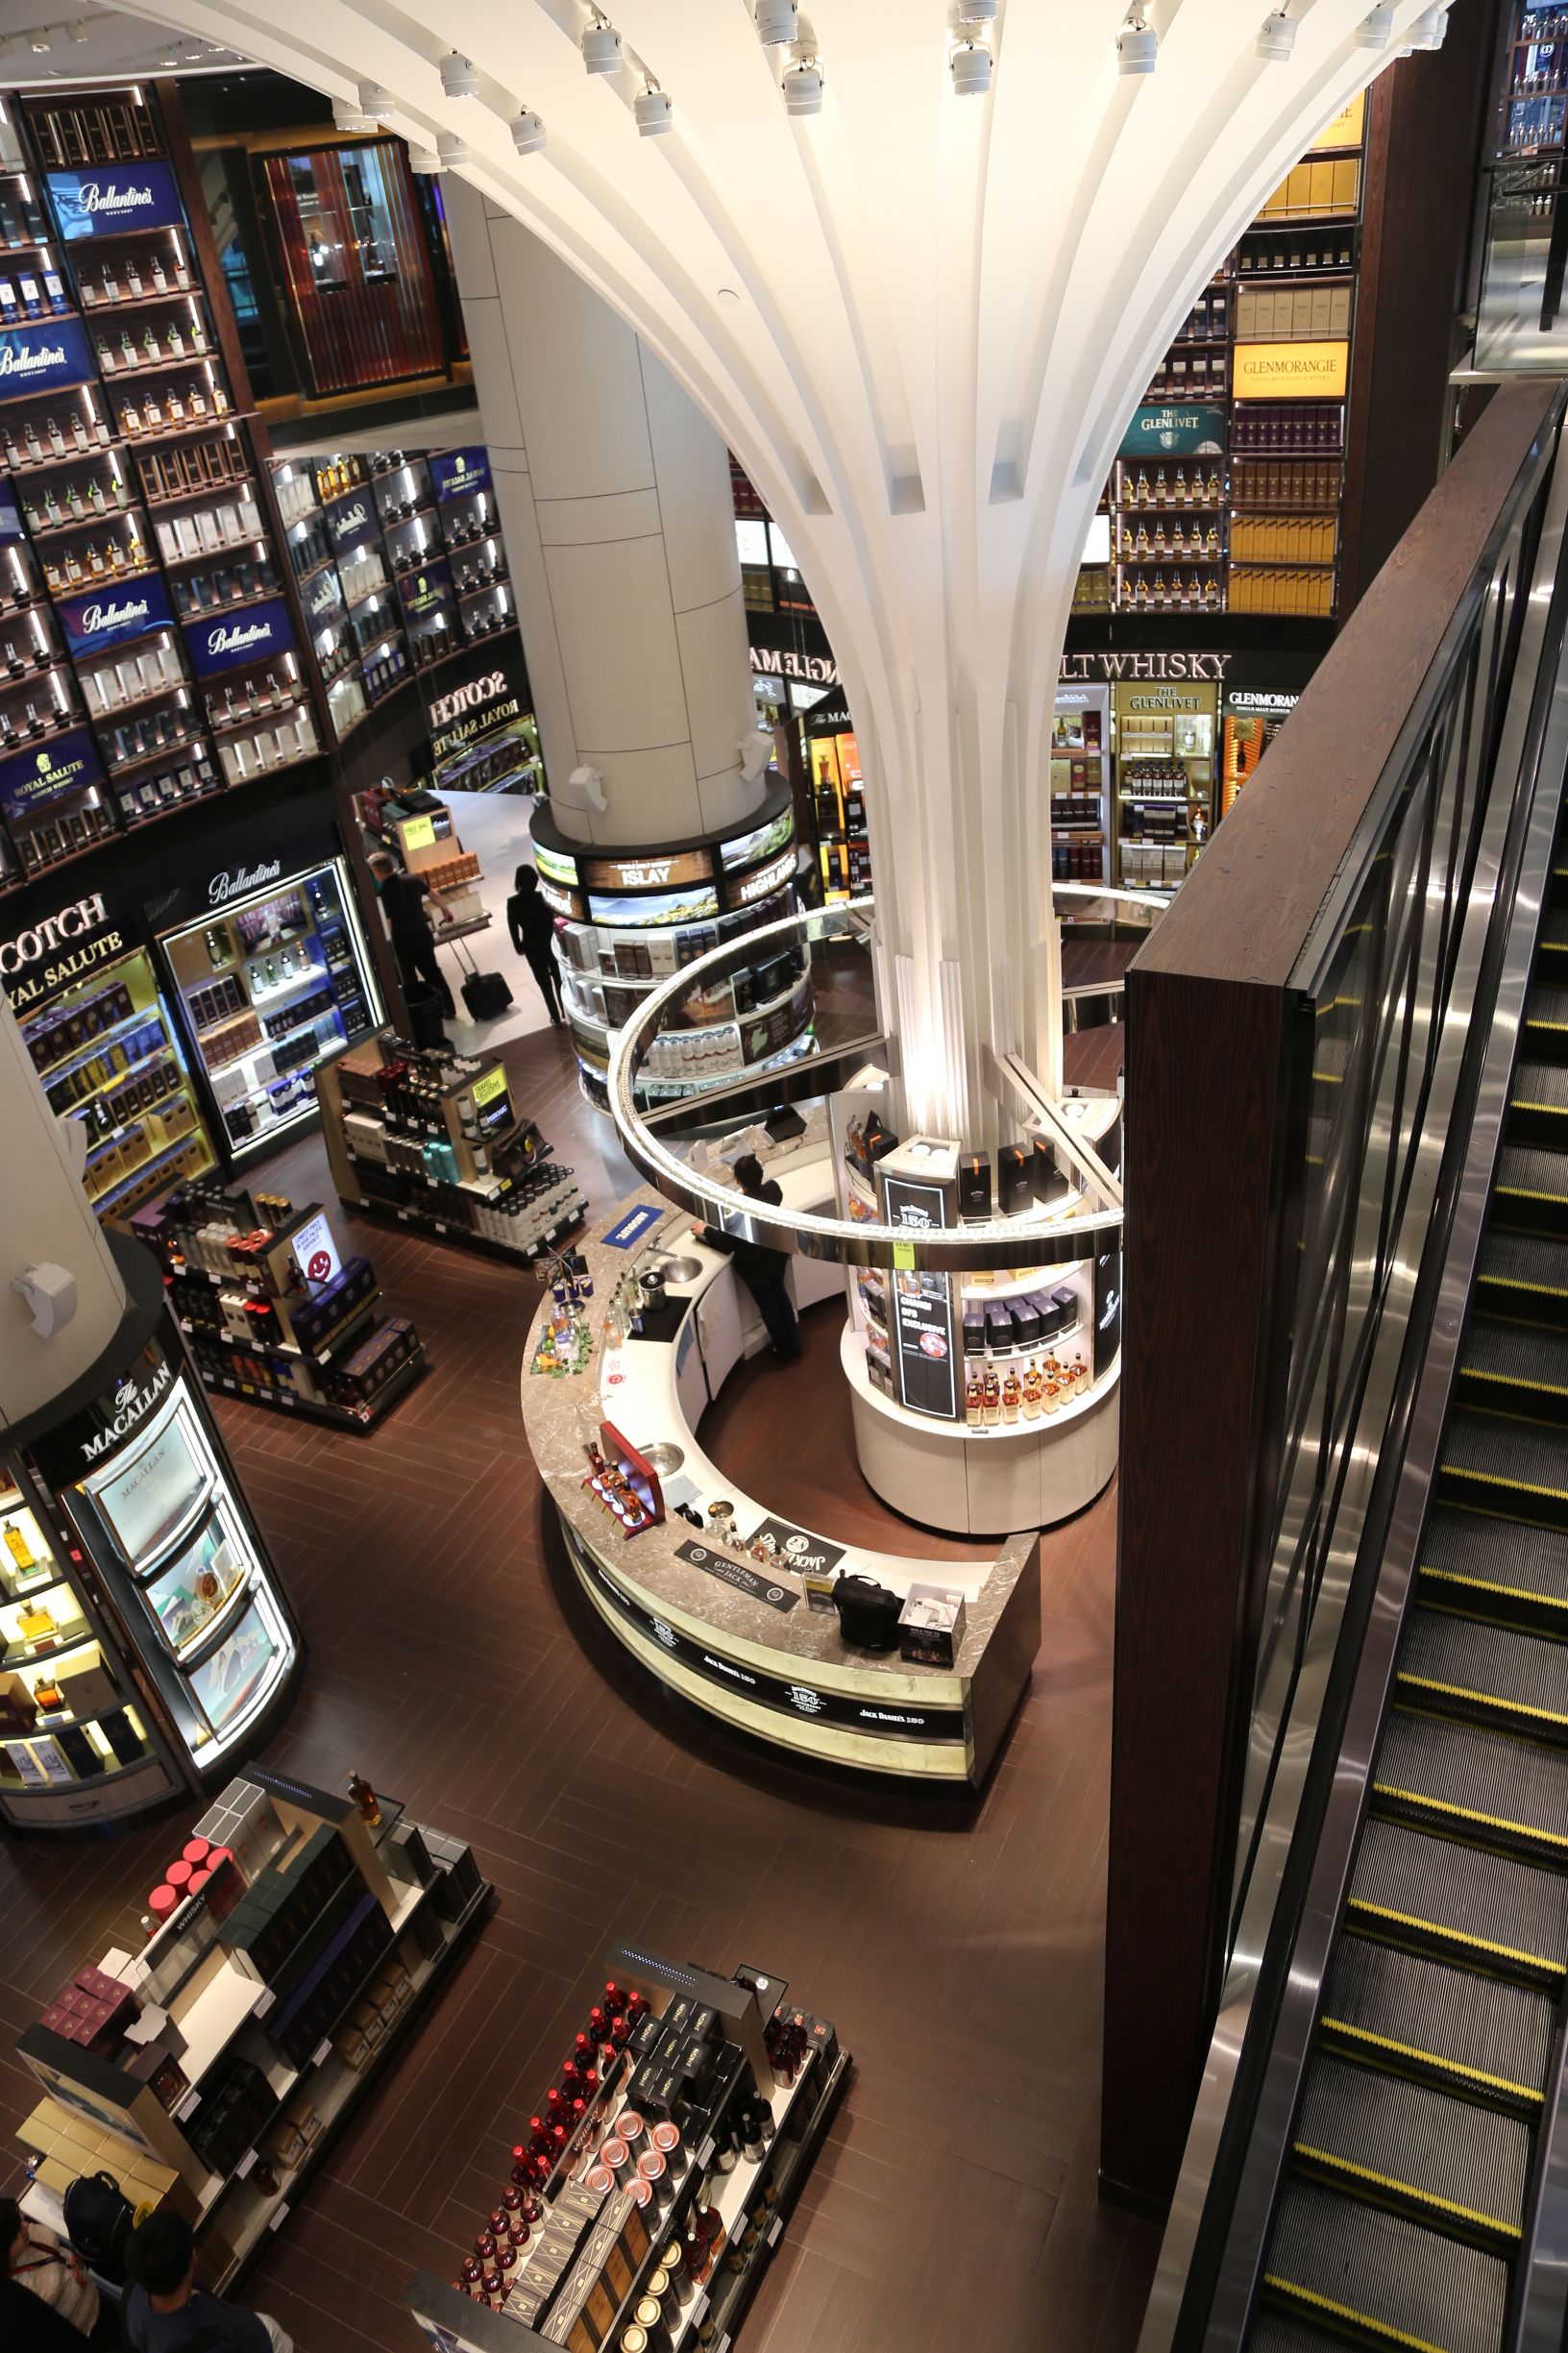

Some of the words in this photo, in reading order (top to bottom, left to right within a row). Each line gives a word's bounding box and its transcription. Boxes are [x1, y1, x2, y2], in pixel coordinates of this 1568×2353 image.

[78, 183, 153, 213] Ballantine's
[0, 346, 65, 376] Ballantine's
[1243, 359, 1337, 374] GLENMORANGIE
[1140, 416, 1199, 430] GLENLIVET
[1161, 409, 1179, 418] THE
[83, 599, 148, 634] Ballantine's
[208, 623, 271, 655] Ballantine's
[1059, 653, 1094, 679] LT
[1098, 653, 1232, 679] WHISKY
[1130, 696, 1201, 710] GLENLIVET
[1155, 687, 1176, 697] THE
[1229, 692, 1300, 707] GLENMORAN
[45, 759, 85, 783] SALUTE
[208, 859, 281, 904] Ballantine's
[622, 867, 671, 886] ISLAY
[0, 893, 110, 974] COTCH
[8, 978, 44, 1010] YAL
[44, 931, 123, 988] SALUTE
[902, 1317, 946, 1336] EXCLUSIVE
[114, 1378, 137, 1413] The
[80, 1360, 174, 1462] MACALLAN
[121, 1449, 166, 1500] MACALLAN
[714, 1561, 759, 1586] GENTLEMAN
[723, 1571, 743, 1582] JACK
[177, 1894, 206, 1930] WHISKY
[574, 2105, 599, 2152] WHISKY
